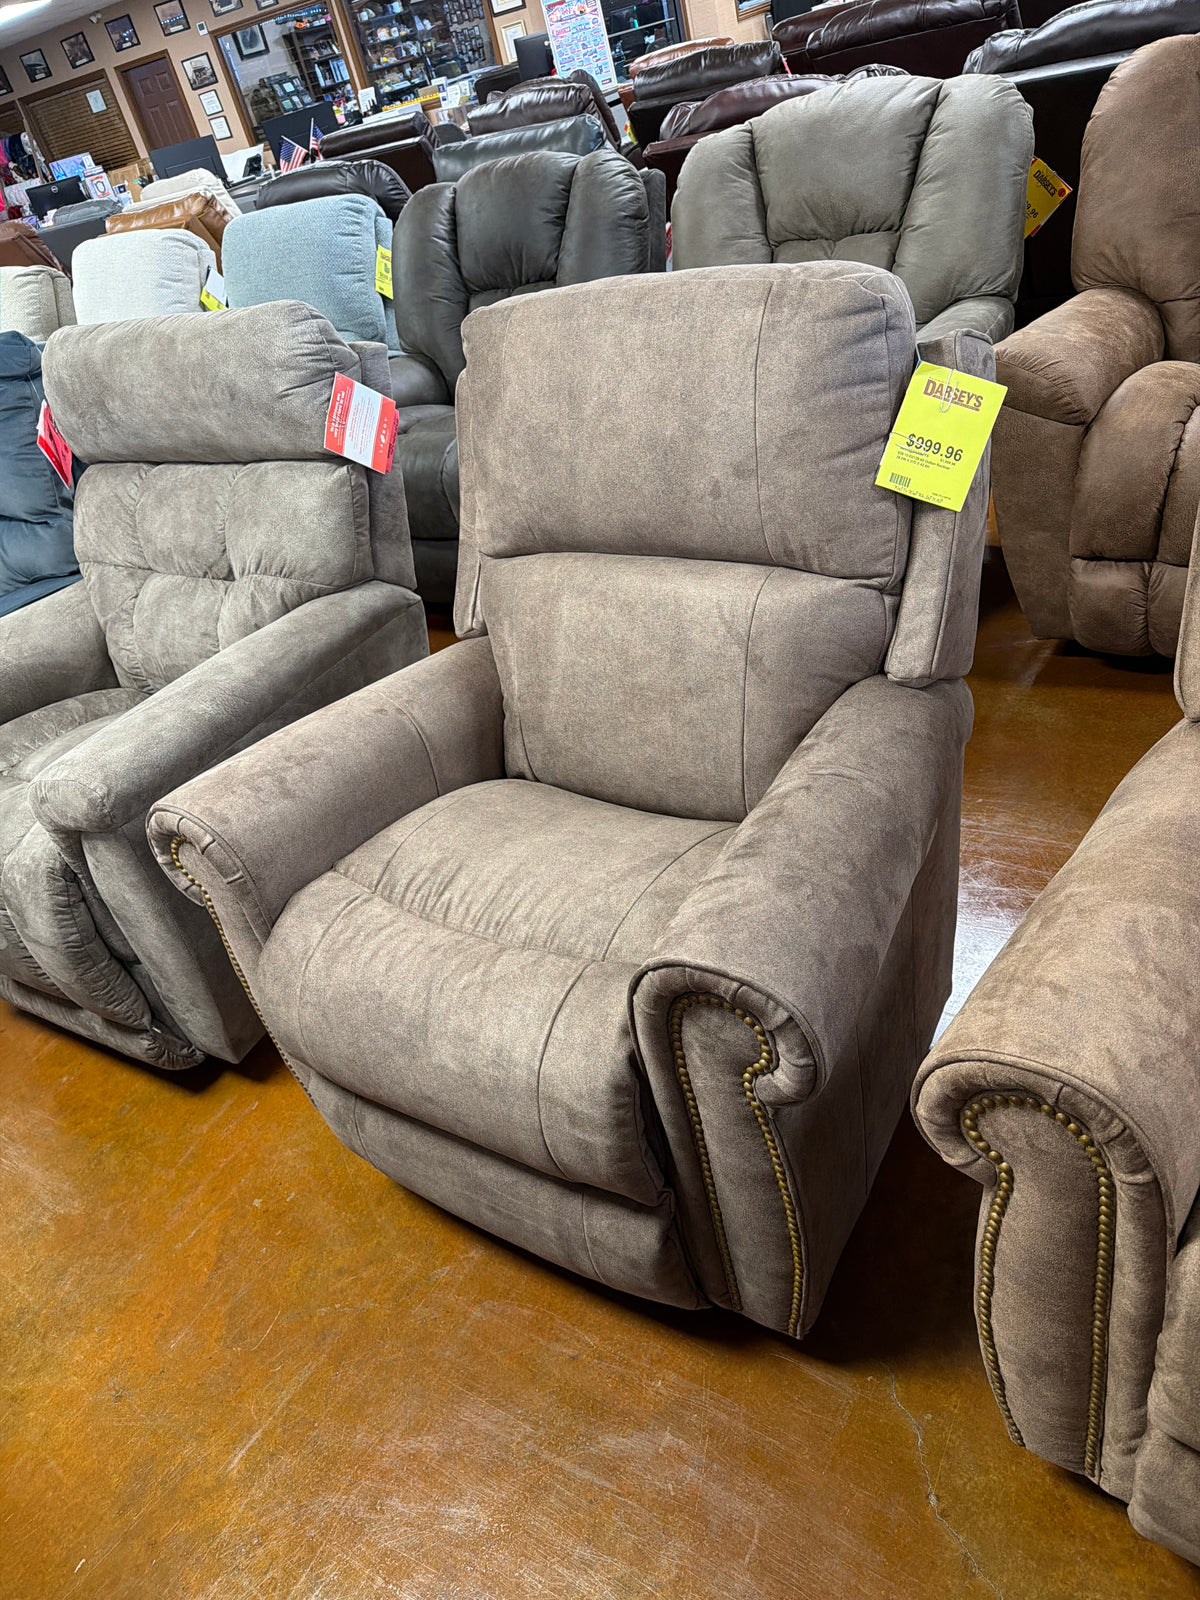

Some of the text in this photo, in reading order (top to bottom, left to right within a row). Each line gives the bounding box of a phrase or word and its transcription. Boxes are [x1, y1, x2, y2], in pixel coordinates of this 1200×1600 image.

[1033, 170, 1057, 196] DARSEY'S
[1025, 200, 1039, 218] 9.96
[923, 378, 983, 408] DARSEY'S
[906, 433, 963, 462] $999.96
